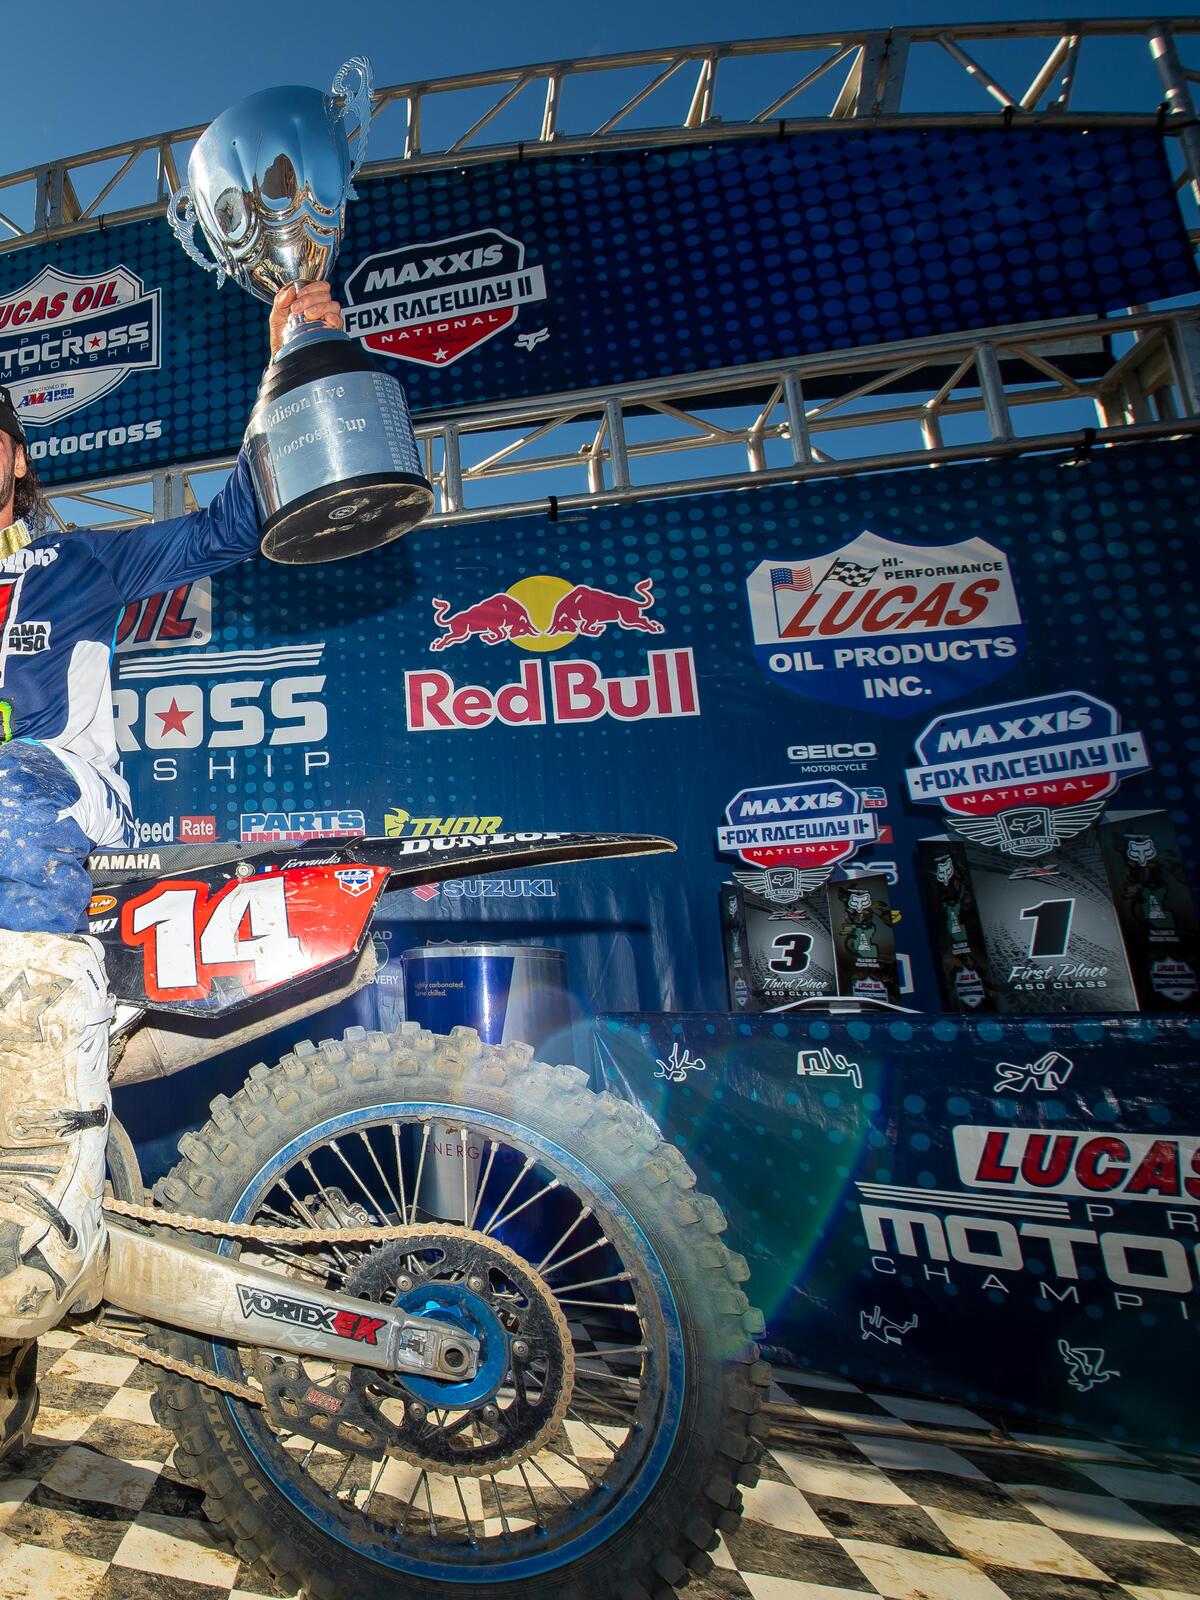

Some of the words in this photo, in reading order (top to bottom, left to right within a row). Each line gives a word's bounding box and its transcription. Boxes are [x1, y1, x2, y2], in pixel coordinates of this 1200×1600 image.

[364, 244, 503, 293] MAXXIS
[72, 281, 119, 313] OIL
[345, 304, 390, 333] FOX
[393, 280, 513, 320] RACEWAY
[518, 276, 533, 297] II
[20, 328, 72, 345] PRO
[381, 314, 499, 344] NATIONAL
[16, 390, 53, 409] AMA
[54, 387, 75, 397] PRO
[27, 420, 162, 460] otocross
[881, 557, 904, 569] HI-
[884, 561, 1004, 581] PERFORMANCE
[779, 578, 1001, 638] LUCAS
[8, 624, 47, 637] AMA
[8, 636, 46, 652] 450
[769, 651, 824, 674] OIL
[834, 637, 1017, 669] PRODUCTS
[404, 659, 547, 732] Red
[550, 647, 701, 724] Bull
[864, 676, 933, 700] INC.
[111, 675, 328, 752] ROSS
[937, 706, 1092, 753] MAXXIS
[786, 742, 878, 761] GEICO
[120, 750, 331, 782] SHIP
[801, 762, 869, 774] MOTORCYCLE
[920, 765, 970, 792] FOX
[973, 743, 1103, 784] RACEWAY
[963, 780, 1094, 805] NATIONAL
[739, 792, 842, 818] MAXXIS
[135, 816, 174, 843] teed
[182, 819, 214, 837] Rate
[241, 810, 365, 832] PARTS
[408, 816, 503, 836] THOR
[726, 828, 759, 845] FOX
[761, 820, 850, 842] RACEWAY
[752, 844, 840, 857] NATIONAL
[1004, 840, 1018, 849] FOX
[1019, 837, 1056, 847] RACEWAY
[88, 853, 161, 870] YAMAHA
[282, 854, 342, 869] Ferrandis
[442, 879, 554, 898] SUZUKI
[133, 876, 299, 989] 14
[1019, 898, 1076, 959] 1
[768, 932, 814, 974] 3
[762, 977, 796, 991] Third
[795, 977, 829, 990] Place
[1007, 964, 1054, 983] First
[1056, 963, 1111, 980] Place
[1014, 982, 1046, 990] 450
[1053, 980, 1107, 989] CLASS
[425, 1141, 481, 1161] ENERG
[974, 1131, 1200, 1198] LUCA
[860, 1203, 1200, 1293] MOTO
[240, 1287, 337, 1333] VORTEX
[331, 1310, 387, 1346] EK
